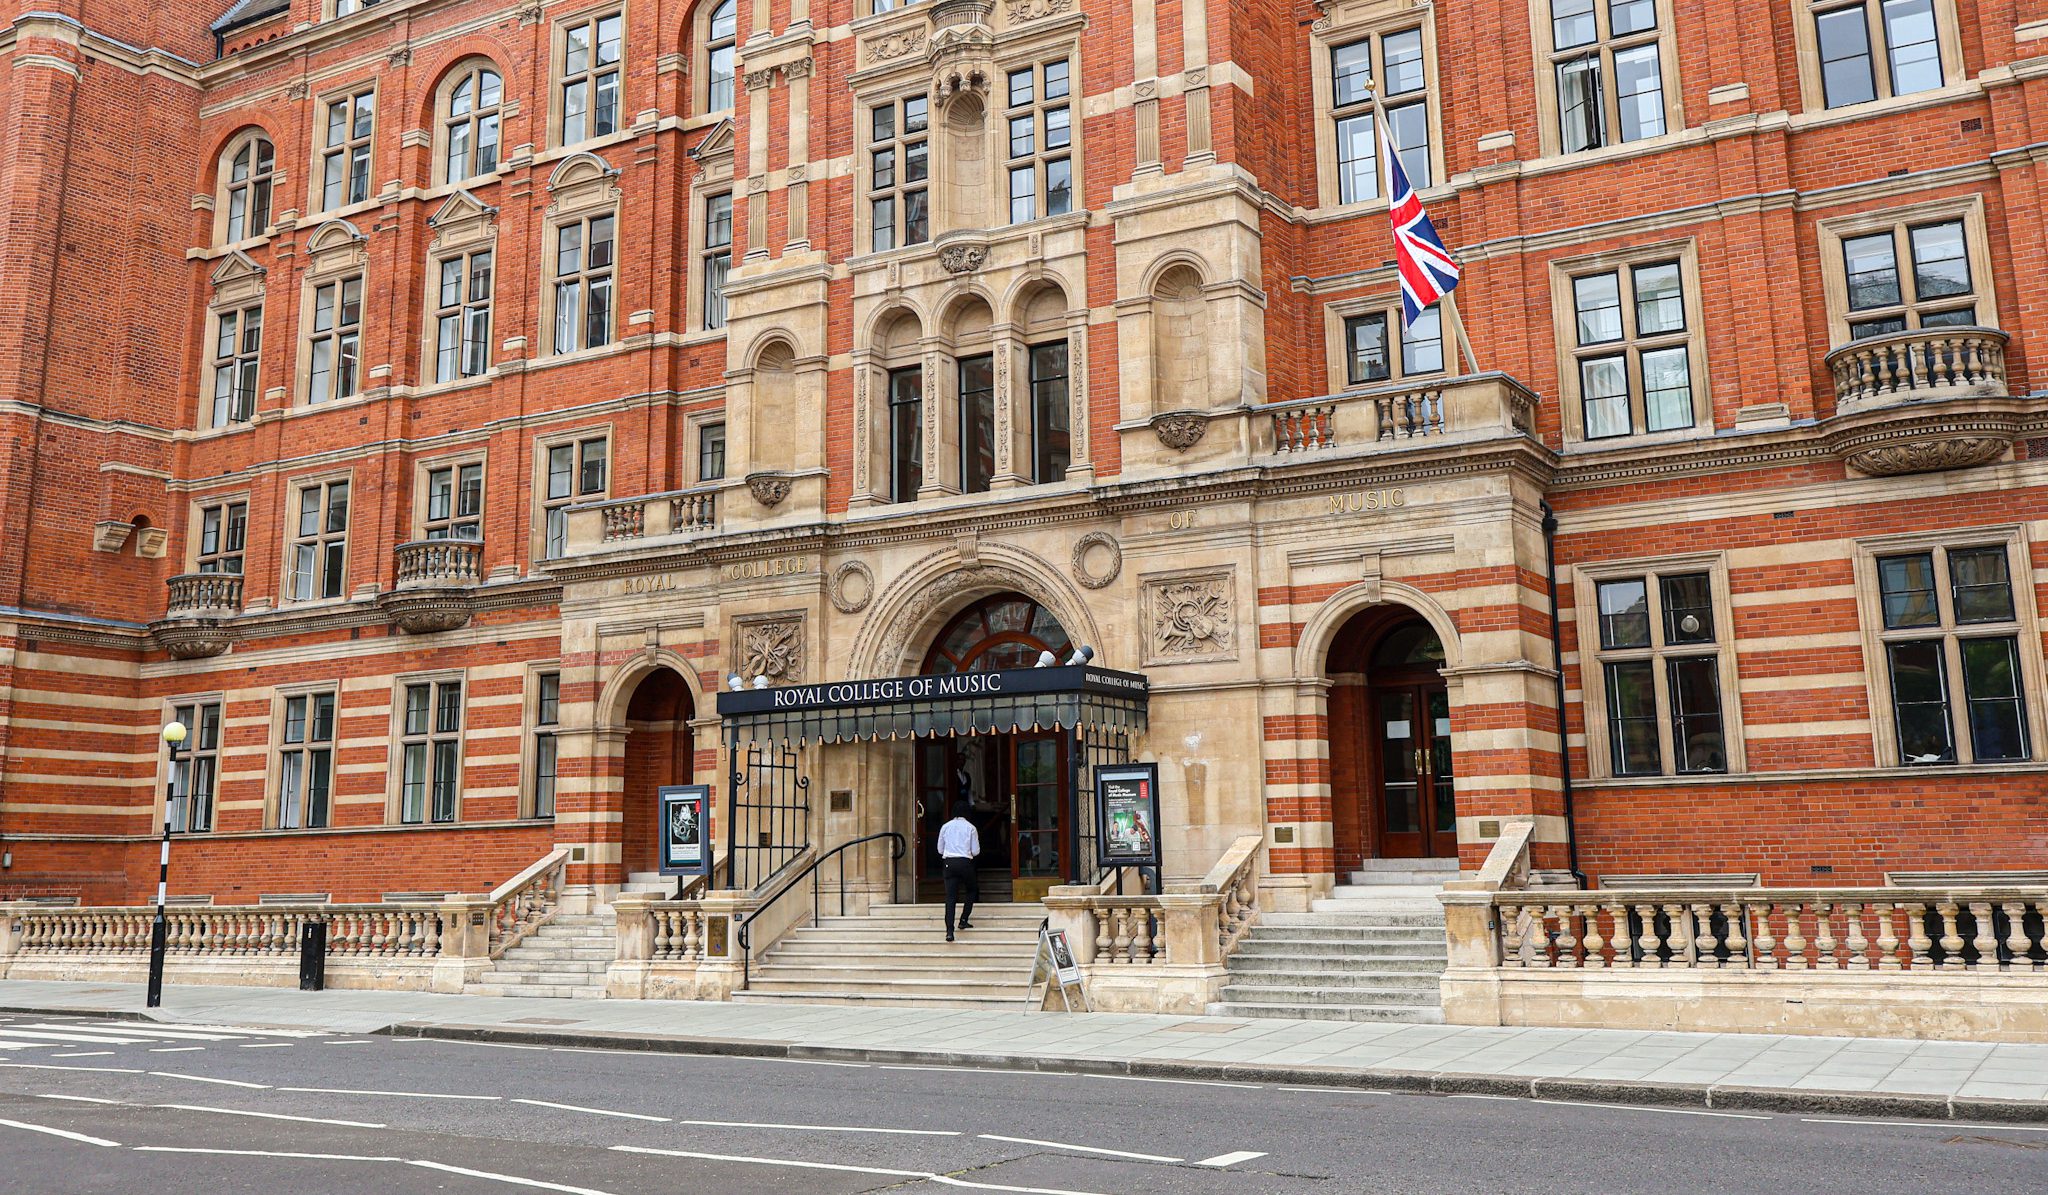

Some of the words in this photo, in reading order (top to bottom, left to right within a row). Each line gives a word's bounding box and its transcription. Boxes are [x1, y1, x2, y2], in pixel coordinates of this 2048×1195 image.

[623, 574, 677, 595] ROYAL
[730, 556, 808, 581] COLLEGE
[1169, 509, 1197, 530] OF
[1328, 488, 1404, 514] MUSIC
[774, 688, 824, 706] ROYAL
[828, 681, 903, 702] COLLEGE
[909, 679, 933, 696] OF
[939, 673, 1001, 694] MUSIC
